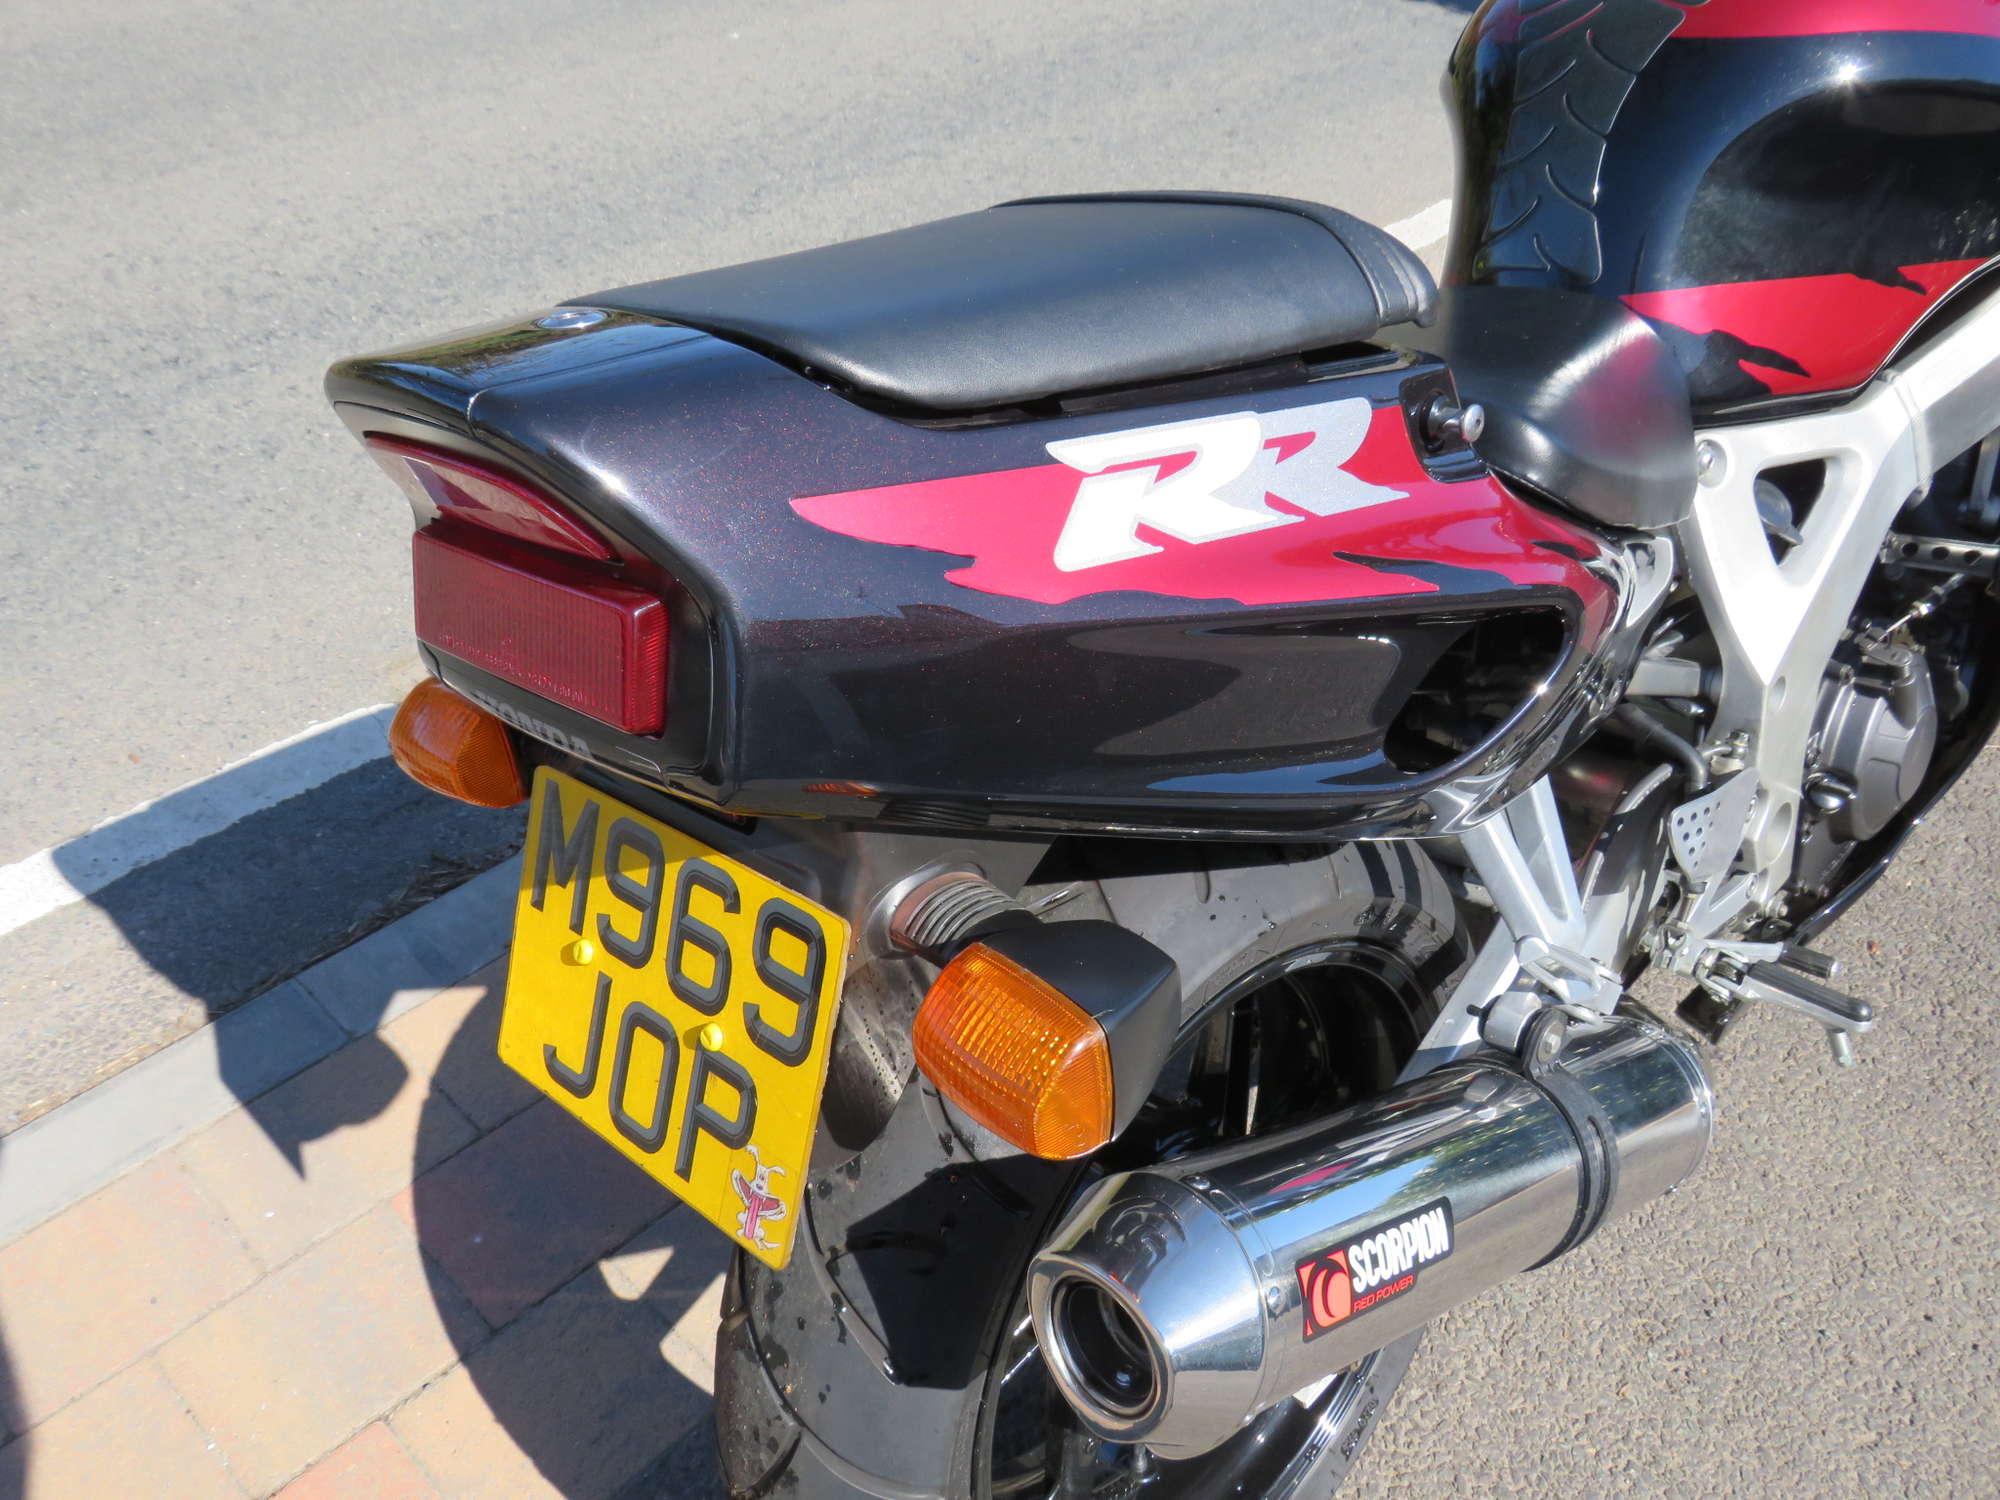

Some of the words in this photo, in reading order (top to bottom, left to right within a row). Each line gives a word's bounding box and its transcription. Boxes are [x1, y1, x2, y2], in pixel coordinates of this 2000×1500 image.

[1045, 396, 1411, 573] RR
[530, 777, 827, 1067] M969
[543, 971, 759, 1183] JOP
[1348, 1207, 1450, 1293] SCORPION
[1353, 1294, 1376, 1313] RED
[1376, 1275, 1414, 1302] POWER
